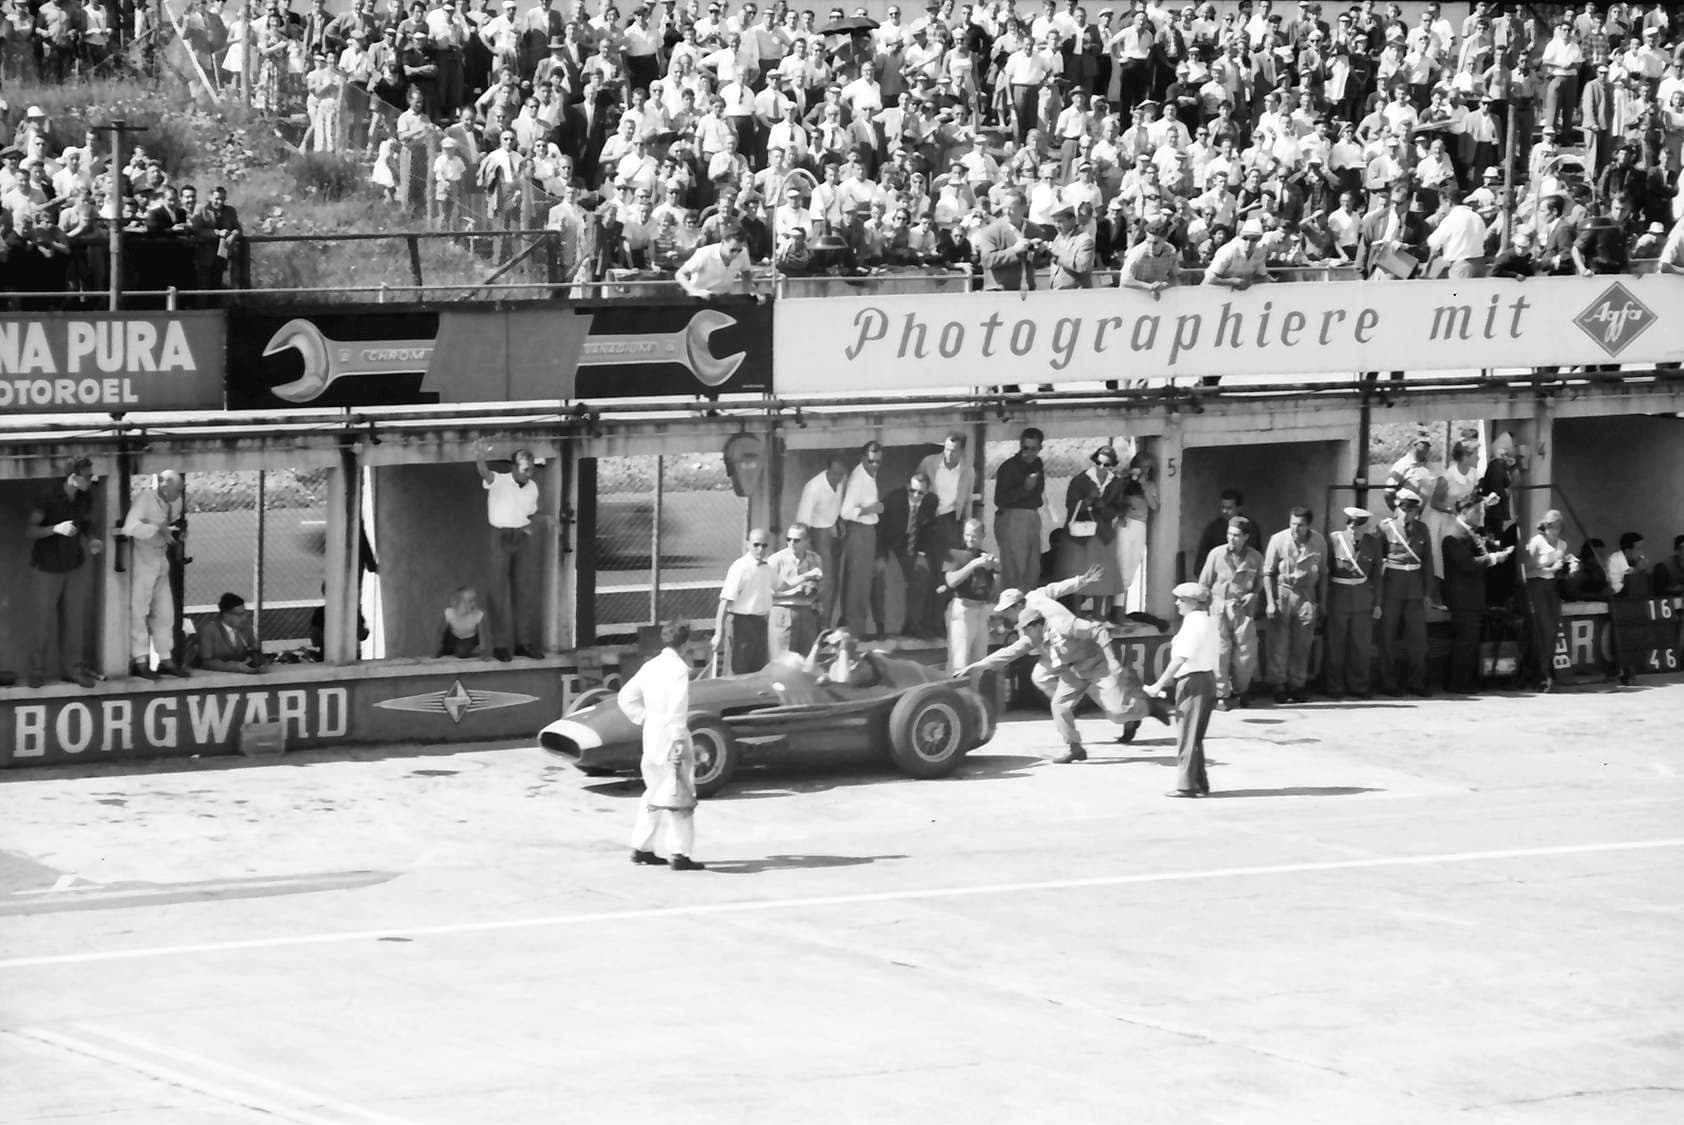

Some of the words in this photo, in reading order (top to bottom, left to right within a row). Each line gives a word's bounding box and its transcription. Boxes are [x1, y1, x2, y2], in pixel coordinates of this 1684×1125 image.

[844, 301, 1379, 371] Photographiere
[1429, 293, 1532, 341] mit
[1583, 300, 1643, 344] Agfa
[67, 320, 197, 373] PURA
[368, 349, 425, 361] CHROM
[1167, 457, 1177, 478] 5
[1648, 599, 1672, 620] 16
[1649, 648, 1677, 669] 46
[13, 687, 348, 758] BORGWARD
